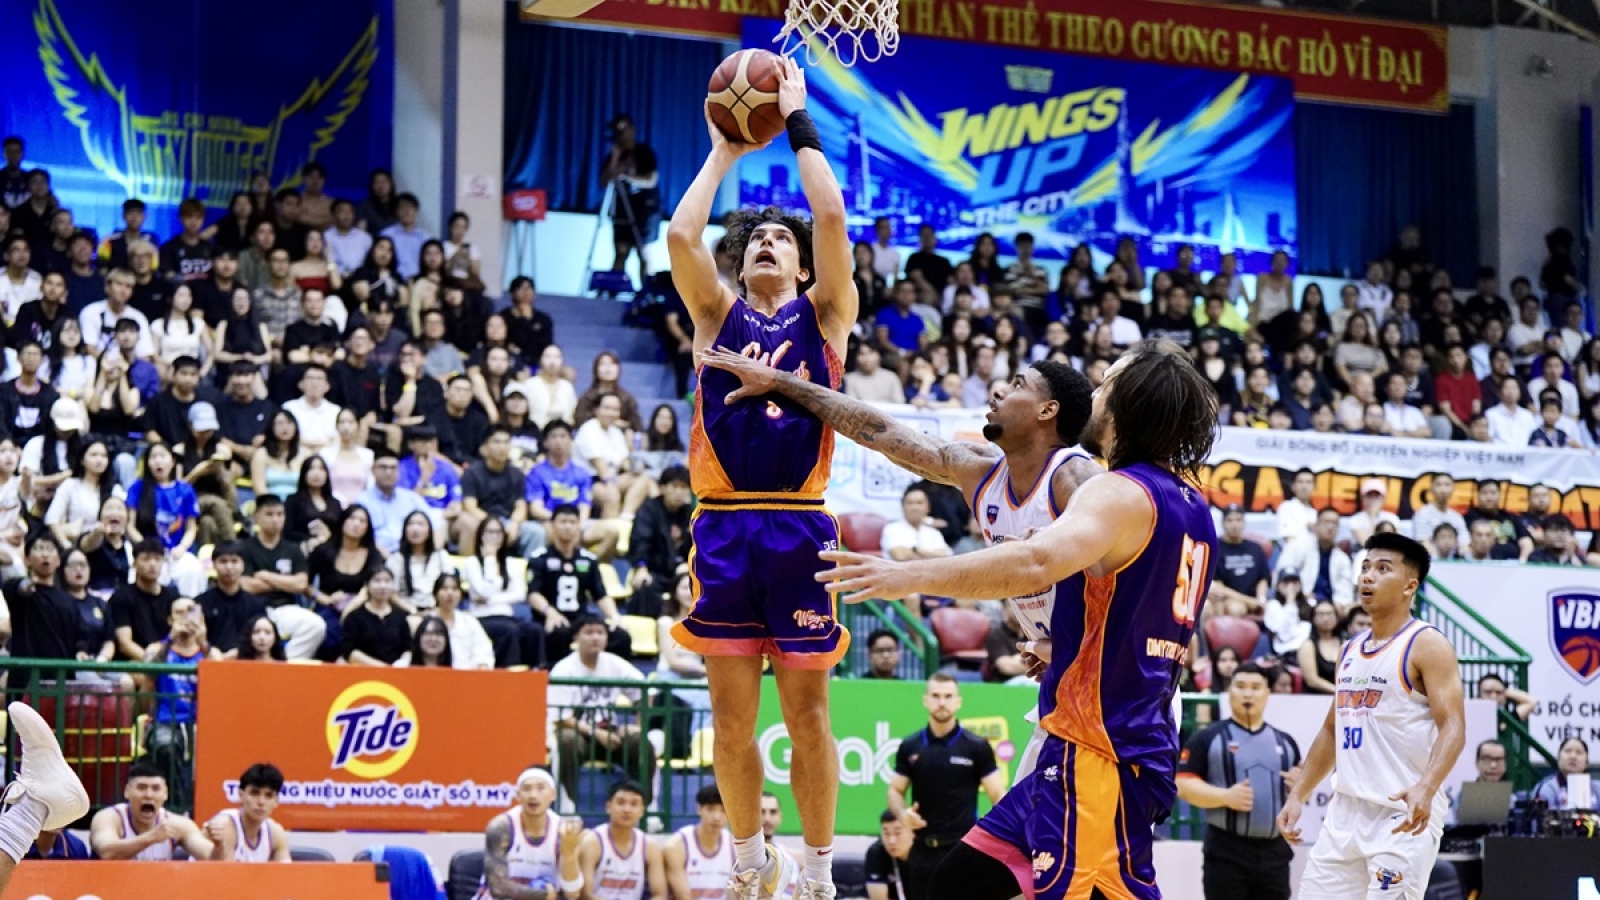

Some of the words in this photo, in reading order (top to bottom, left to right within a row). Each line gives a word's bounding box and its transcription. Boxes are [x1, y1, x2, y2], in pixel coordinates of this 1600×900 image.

[1046, 11, 1124, 56] THEO
[1237, 23, 1291, 72] BÁC
[1343, 36, 1372, 81] VĨ
[1378, 46, 1422, 93] ĐẠI
[937, 86, 1126, 161] WINGS
[972, 134, 1088, 206] UP
[974, 200, 1020, 226] THE
[1250, 466, 1286, 512] A
[556, 575, 580, 612] 8
[1172, 532, 1210, 629] 51
[333, 707, 413, 766] Tide
[758, 721, 900, 785] Gab
[1343, 727, 1363, 749] 30
[227, 784, 299, 797] TNG
[305, 782, 345, 799] HIỆU
[351, 783, 398, 799] NƯỚC
[450, 784, 471, 800] SỐ
[476, 789, 482, 800] 1
